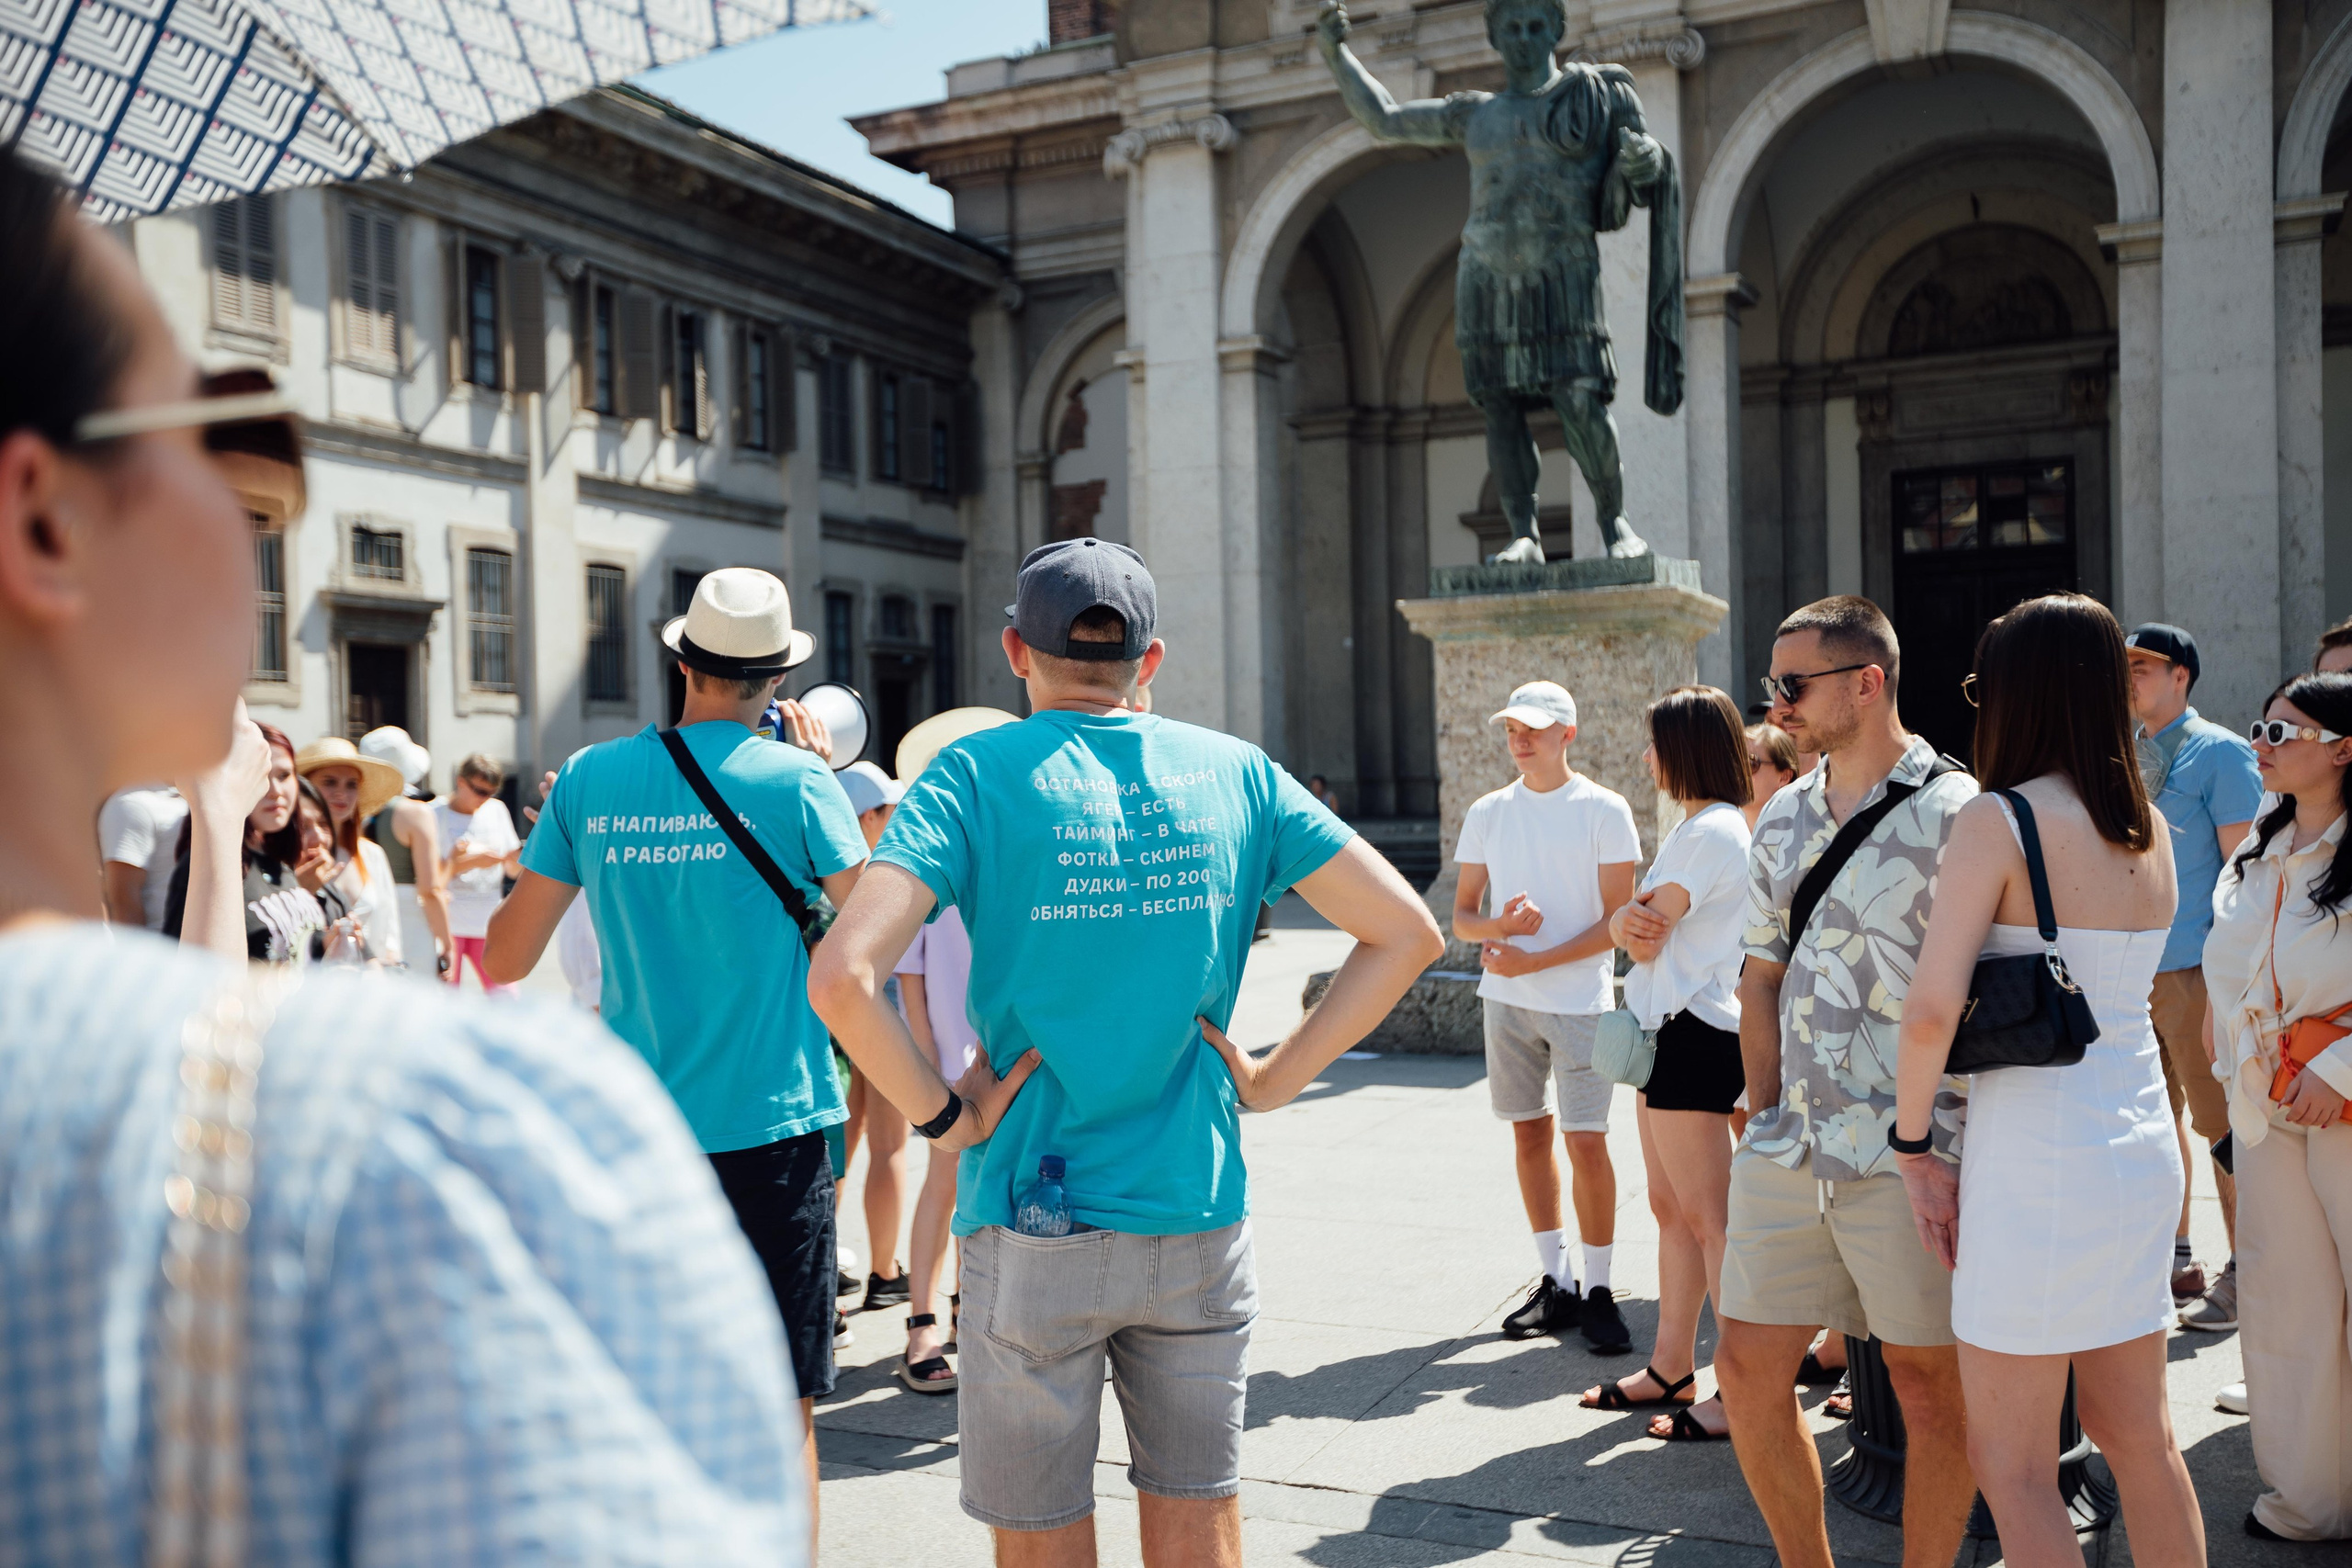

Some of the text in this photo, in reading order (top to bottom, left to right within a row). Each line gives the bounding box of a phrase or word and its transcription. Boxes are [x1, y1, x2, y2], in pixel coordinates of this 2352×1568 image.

[1034, 777, 1141, 796] ОСТАНОВКА
[1160, 770, 1216, 788] СКОРО
[1082, 801, 1122, 817] ЯГЕР
[1141, 796, 1186, 817] ЕСТЬ
[587, 812, 756, 834] НЕ НАПИВАЮЬ,
[1052, 822, 1136, 842] ТАЙМИНГ
[1158, 823, 1170, 838] В
[1174, 817, 1217, 834] ЧАТЕ
[605, 841, 727, 864] А РАБОТАЮ
[1057, 851, 1120, 867] ФОТКИ
[1139, 842, 1216, 866] СКИНЕМ
[1064, 877, 1126, 896] ДУДКИ
[1146, 874, 1171, 890] ПО
[1177, 868, 1210, 886] 200
[1030, 903, 1124, 921] ОБНЯТЬСЯ
[1142, 893, 1235, 917] БЕСПЛАТНО
